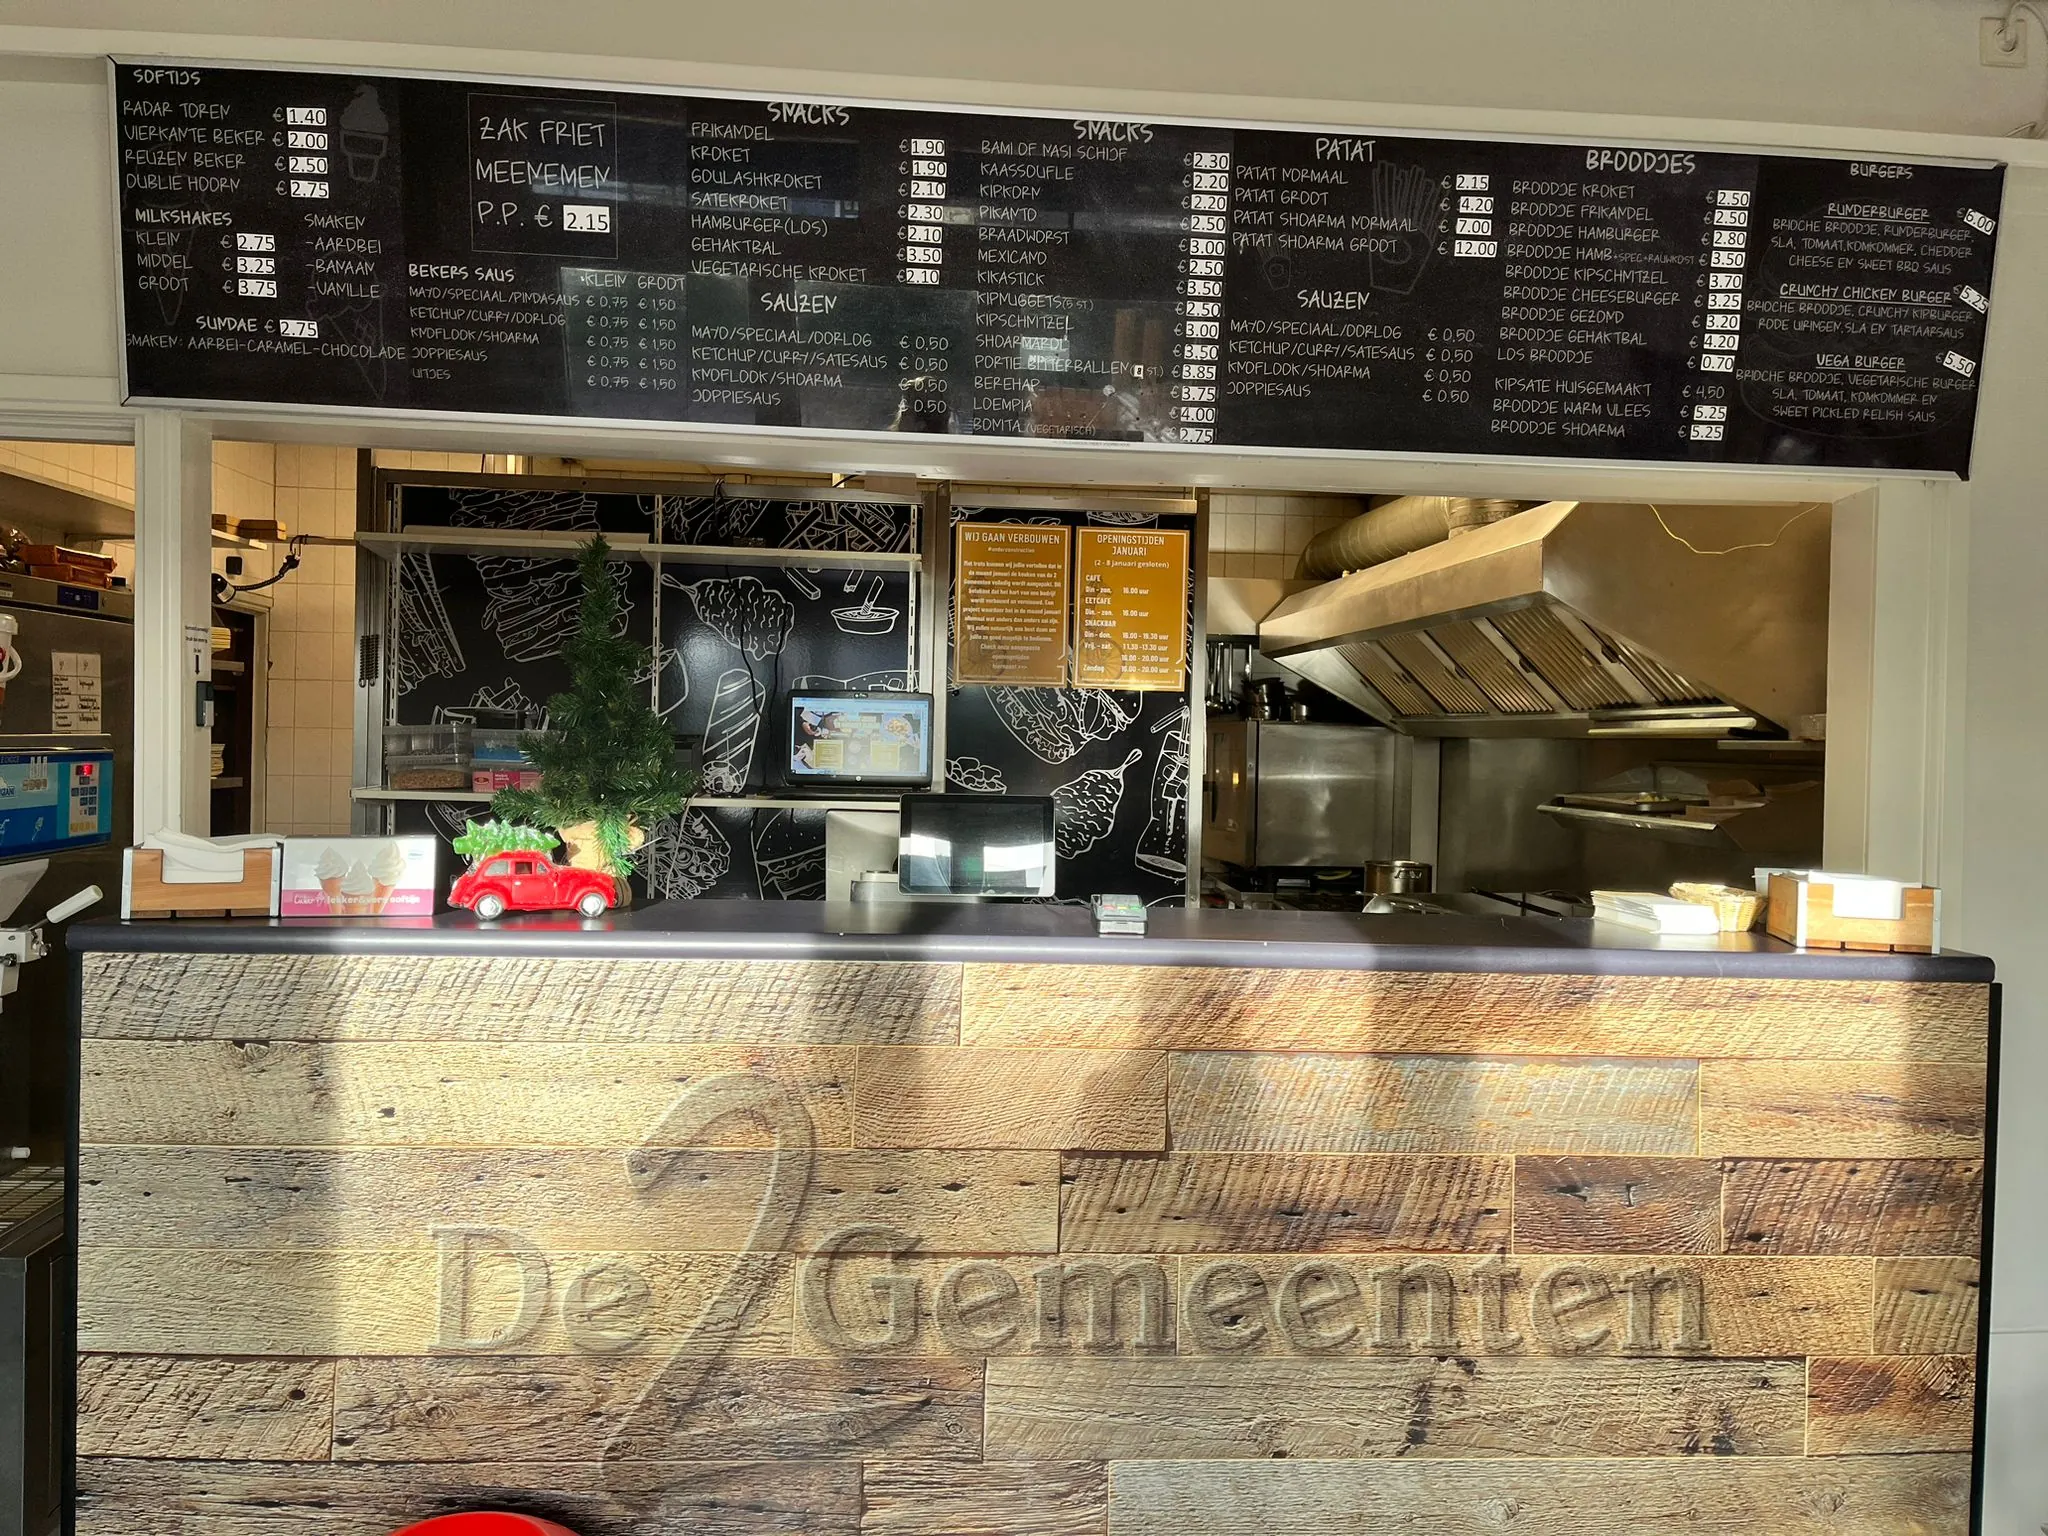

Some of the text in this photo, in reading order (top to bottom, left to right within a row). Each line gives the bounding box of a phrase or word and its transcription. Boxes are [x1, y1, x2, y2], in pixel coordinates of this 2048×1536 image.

[122, 100, 232, 120] RADAR TOREN
[288, 108, 326, 125] 1.40
[766, 102, 850, 126] SNACKS
[124, 124, 266, 146] VIERKANTE BEKER
[478, 116, 606, 148] ZAK FRIET
[692, 122, 774, 142] FRIKANDEL
[1072, 120, 1154, 144] SNACKS
[288, 132, 328, 150] 2.00
[912, 140, 944, 156] 1.90
[980, 140, 1013, 156] BAMI
[1018, 142, 1037, 156] OF
[1042, 144, 1072, 158] NASI
[690, 146, 750, 164] KROKET
[1316, 137, 1376, 162] PATAT
[124, 148, 247, 170] REUZEN BEKER
[288, 158, 328, 174] 2.50
[1194, 154, 1229, 170] 2.30
[1586, 150, 1696, 175] BROODJES
[476, 158, 610, 190] MEENEMEN
[913, 162, 946, 177] 1.90
[980, 162, 1075, 181] KAASSOUFLE
[1236, 165, 1349, 185] PATAT NORMAAL
[1850, 162, 1914, 180] BURGERS
[126, 174, 240, 194] OUBLIE HOORN
[690, 168, 822, 190] GOULASHKROKET
[1194, 174, 1228, 190] 2.20
[1456, 176, 1488, 190] 2.15
[290, 180, 329, 198] 2.75
[912, 182, 946, 198] 2.10
[980, 184, 1042, 200] KIPKORN
[1234, 186, 1329, 206] PATAT GROOT
[1582, 183, 1636, 200] KROKET
[690, 192, 788, 210] SATEKROKET
[1192, 196, 1226, 210] 2.20
[1460, 198, 1494, 212] 4.20
[1718, 192, 1750, 206] 2.50
[134, 208, 234, 228] MILKSHAKES
[909, 206, 942, 220] 2.30
[979, 205, 1038, 222] PIKANTO
[1233, 208, 1418, 232] PATAT SHOARMA NORMAAL
[1580, 204, 1654, 222] FRIKANDEL
[1715, 212, 1748, 226] 2.50
[304, 214, 366, 230] SMAKEN
[566, 212, 609, 231] 2.15
[1192, 218, 1226, 233] 2.50
[1458, 220, 1490, 234] 7.00
[1965, 210, 1995, 234] 6.00
[136, 230, 181, 248] KLEIN
[908, 228, 942, 242] 2.10
[978, 227, 1070, 245] BRAADWORST
[1578, 225, 1660, 242] HAMBURGER
[1714, 232, 1746, 246] 2.80
[236, 234, 276, 251] 2.75
[692, 237, 782, 256] GEHAKTBAL
[1190, 240, 1224, 255] 3.00
[1232, 231, 1398, 253] PATAT SHOARMA GROOT
[1455, 242, 1497, 257] 12.00
[136, 254, 194, 270] MIDDEL
[908, 248, 942, 262] 3.50
[978, 249, 1048, 266] MEXICANO
[1712, 252, 1744, 267] 3.50
[238, 258, 276, 274] 3.25
[408, 263, 516, 283] BEKERS SAUS
[692, 260, 868, 282] VEGETARISCHE KROKET
[1190, 260, 1224, 276] 2.50
[138, 276, 190, 292] GROOT
[584, 272, 686, 292] KLEIN GROOT
[906, 270, 940, 284] 2.10
[977, 270, 1046, 287] KIKASTICK
[1710, 274, 1742, 288] 3.70
[238, 280, 276, 296] 3.75
[1188, 282, 1222, 296] 3.50
[1780, 283, 1952, 304] CRUNCHY CHICKEN BURGER
[760, 292, 838, 314] SAUZEN
[1296, 290, 1370, 310] SAUZEN
[1572, 288, 1680, 306] CHEESEBURGER
[1708, 294, 1741, 308] 3.25
[1962, 286, 1989, 312] 5.25
[1186, 302, 1221, 317] 2.50
[1570, 308, 1625, 324] GEZOND
[196, 316, 258, 333] SUNDAE
[280, 321, 318, 337] 2.75
[1186, 323, 1218, 338] 3.00
[1707, 315, 1739, 330] 3.20
[1568, 330, 1648, 347] GEHAKTBAL
[1704, 335, 1736, 349] 4.20
[1184, 345, 1218, 360] 3.50
[1496, 348, 1526, 362] LOS
[1702, 356, 1734, 371] 0.70
[1816, 353, 1906, 371] VEGA BURGER
[1945, 352, 1974, 376] 5.50
[1182, 364, 1216, 380] 3.85
[974, 376, 1040, 392] BEREHAP
[1494, 378, 1652, 397] KIPSATE HUISGEMAAKT
[1182, 386, 1216, 402] 3.75
[973, 396, 1032, 413] LOEMPIA
[1562, 402, 1602, 416] WARM
[1606, 404, 1652, 418] VLEES
[1180, 408, 1216, 422] 4.00
[1695, 406, 1726, 420] 5.25
[1180, 428, 1214, 442] 2.75
[1562, 422, 1626, 438] SHOARMA
[1692, 425, 1723, 440] 5.25
[964, 532, 1060, 544] WIJ GAAN VERBOUWEN
[1096, 534, 1165, 545] OPENINGSTIJDEN
[1112, 546, 1148, 556] JANUARI
[426, 1222, 652, 1354] De
[802, 1222, 1712, 1356] Gemeenten
